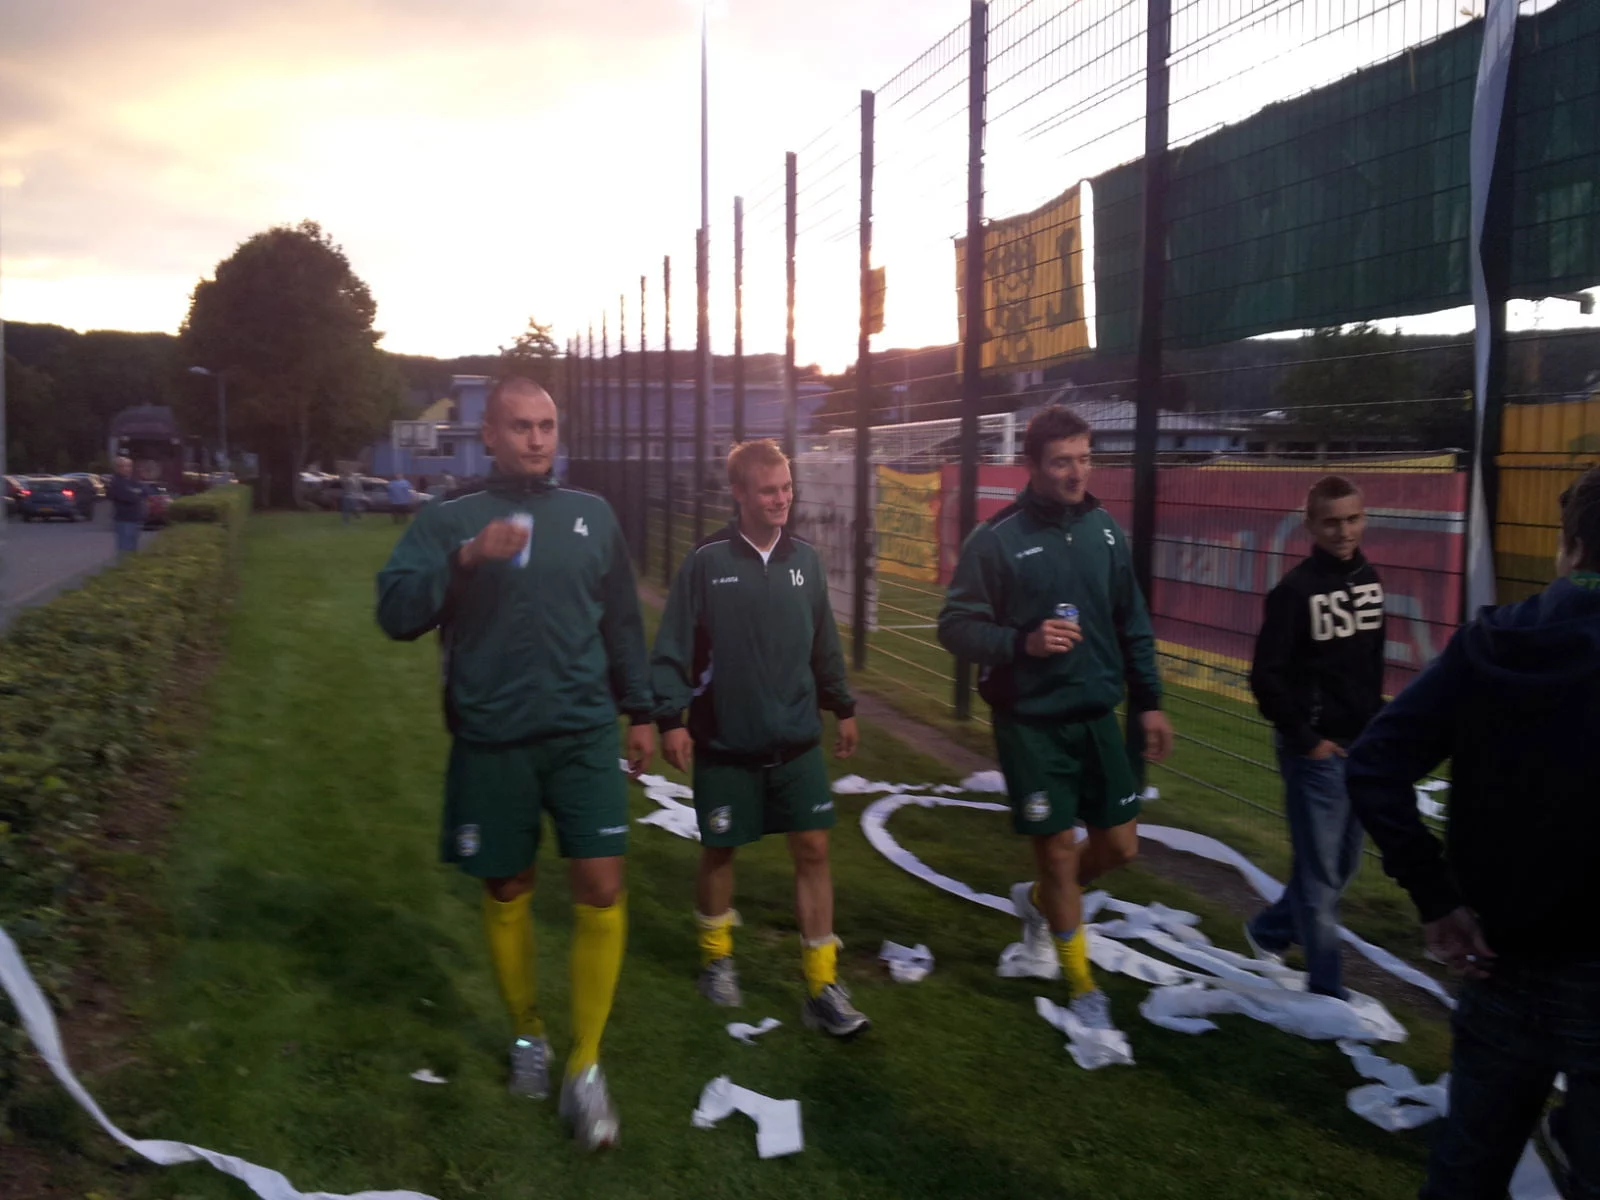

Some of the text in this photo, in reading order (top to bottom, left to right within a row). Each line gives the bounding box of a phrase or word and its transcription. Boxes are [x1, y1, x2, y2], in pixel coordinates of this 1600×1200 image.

[573, 517, 589, 536] 4
[1103, 528, 1115, 545] 5
[789, 568, 804, 586] 16
